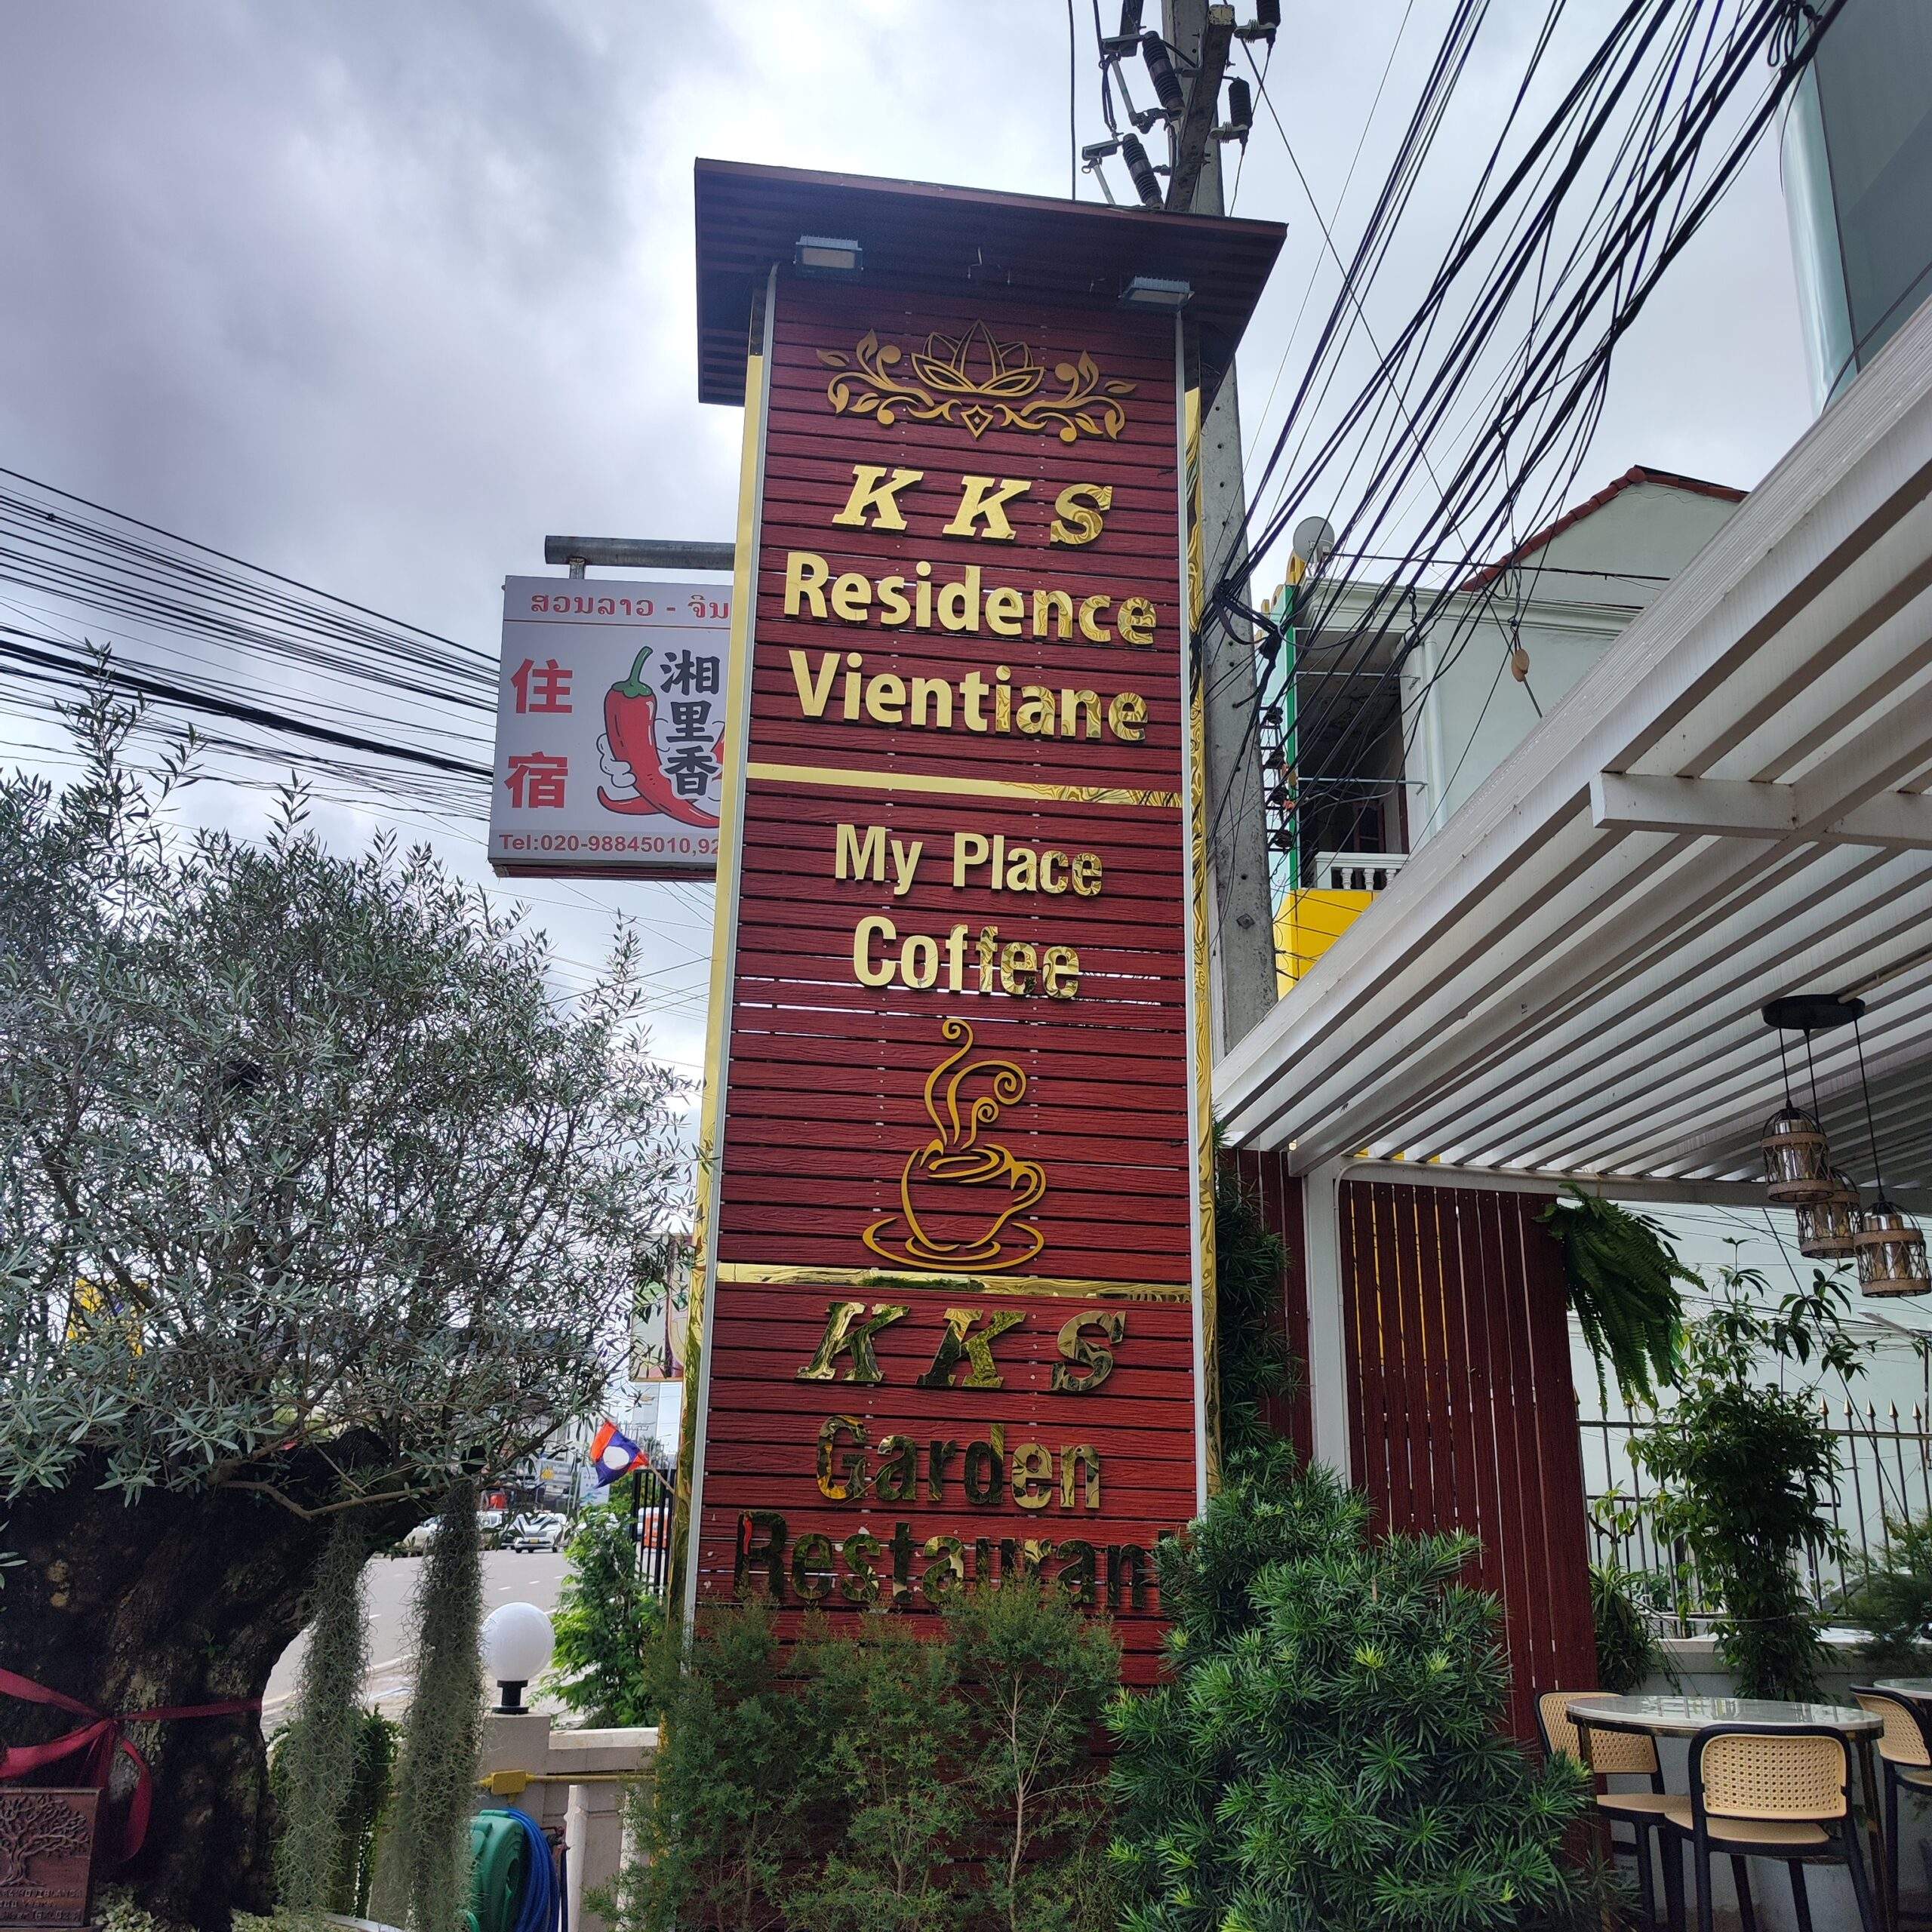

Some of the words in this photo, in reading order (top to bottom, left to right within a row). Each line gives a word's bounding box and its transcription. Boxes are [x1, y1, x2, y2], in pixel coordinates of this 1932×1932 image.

[531, 594, 654, 617] ສວນລາວ
[784, 552, 1157, 645] Residence
[504, 658, 574, 808] 住宿
[660, 649, 720, 796] 湘里香
[789, 650, 1148, 741] Vientiane
[835, 823, 923, 896] My
[953, 832, 1103, 897] Place
[854, 915, 1079, 999] Coffee
[817, 1414, 1100, 1509] Garden
[734, 1510, 1171, 1607] Restauran
